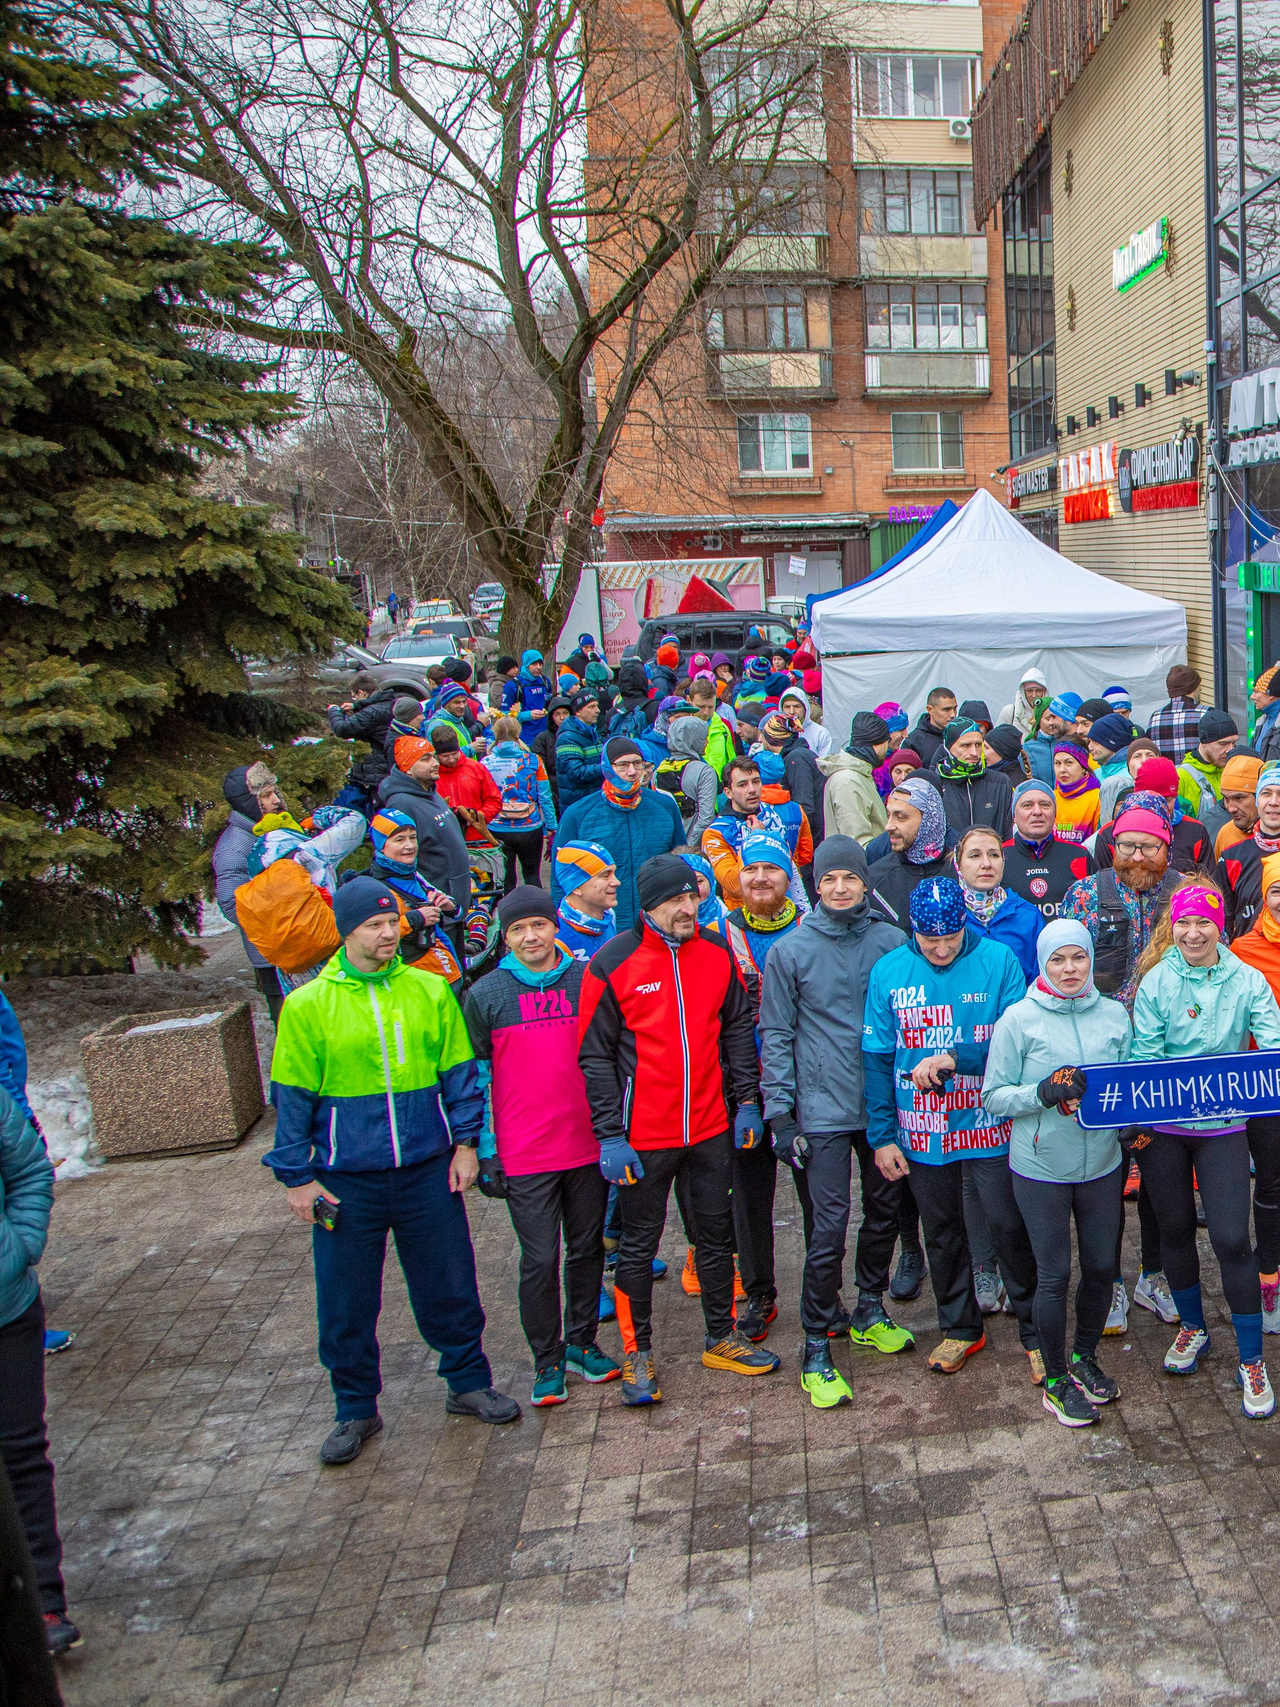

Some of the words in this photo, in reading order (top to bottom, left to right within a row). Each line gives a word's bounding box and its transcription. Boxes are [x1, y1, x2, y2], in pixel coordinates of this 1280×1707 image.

[1059, 442, 1115, 492] ТАБАК
[1012, 473, 1027, 498] SUSHI
[1026, 467, 1049, 495] MASTER
[1057, 823, 1072, 831] RUN
[518, 990, 573, 1022] M226
[890, 985, 927, 1009] 2024
[523, 1019, 575, 1031] MISSION
[898, 1005, 953, 1029] #МЕЧТА
